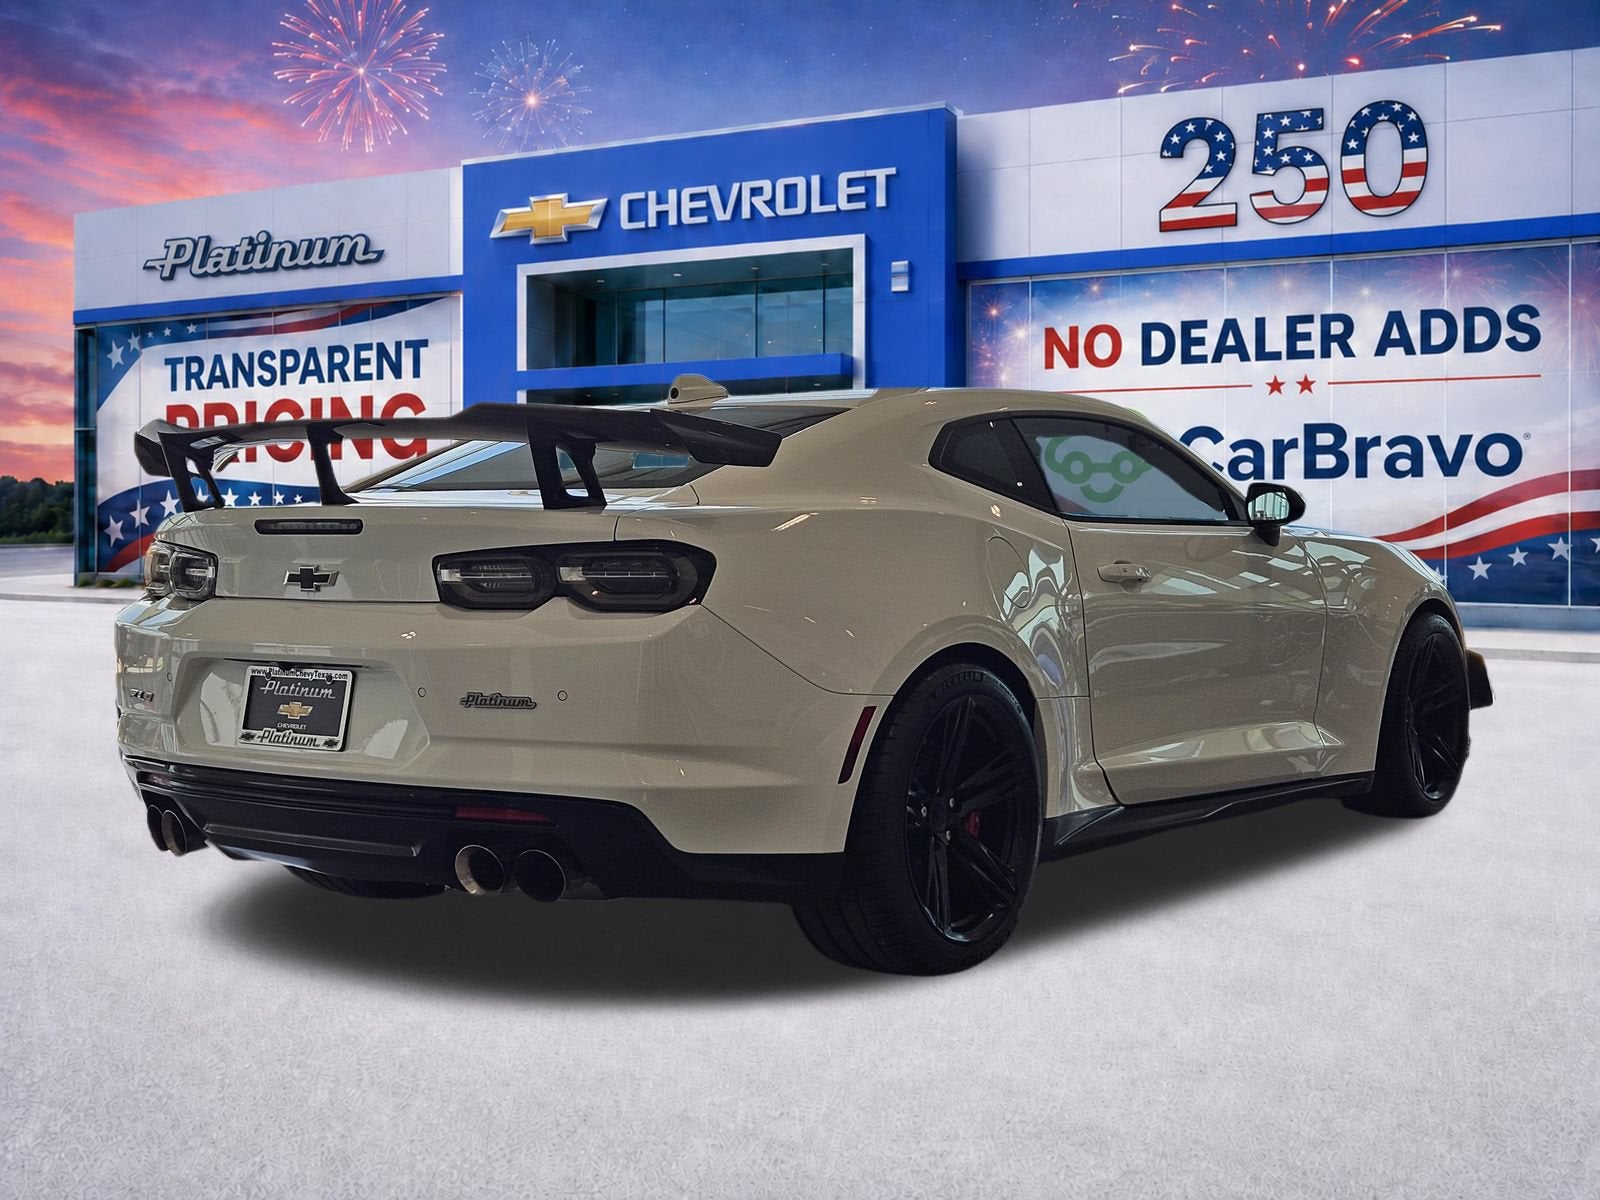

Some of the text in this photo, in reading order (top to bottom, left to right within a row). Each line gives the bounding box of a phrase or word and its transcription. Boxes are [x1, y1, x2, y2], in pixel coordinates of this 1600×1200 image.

[1159, 99, 1430, 233] 250
[620, 167, 897, 230] CHEVROLET
[143, 230, 385, 281] Platinum
[1043, 303, 1543, 370] NO DEALER ADDS
[164, 338, 430, 392] TRANSPARENT
[260, 680, 336, 699] Platinum
[460, 692, 537, 710] Platinum
[257, 729, 320, 747] Platinum
[277, 722, 307, 730] CHEVROLET
